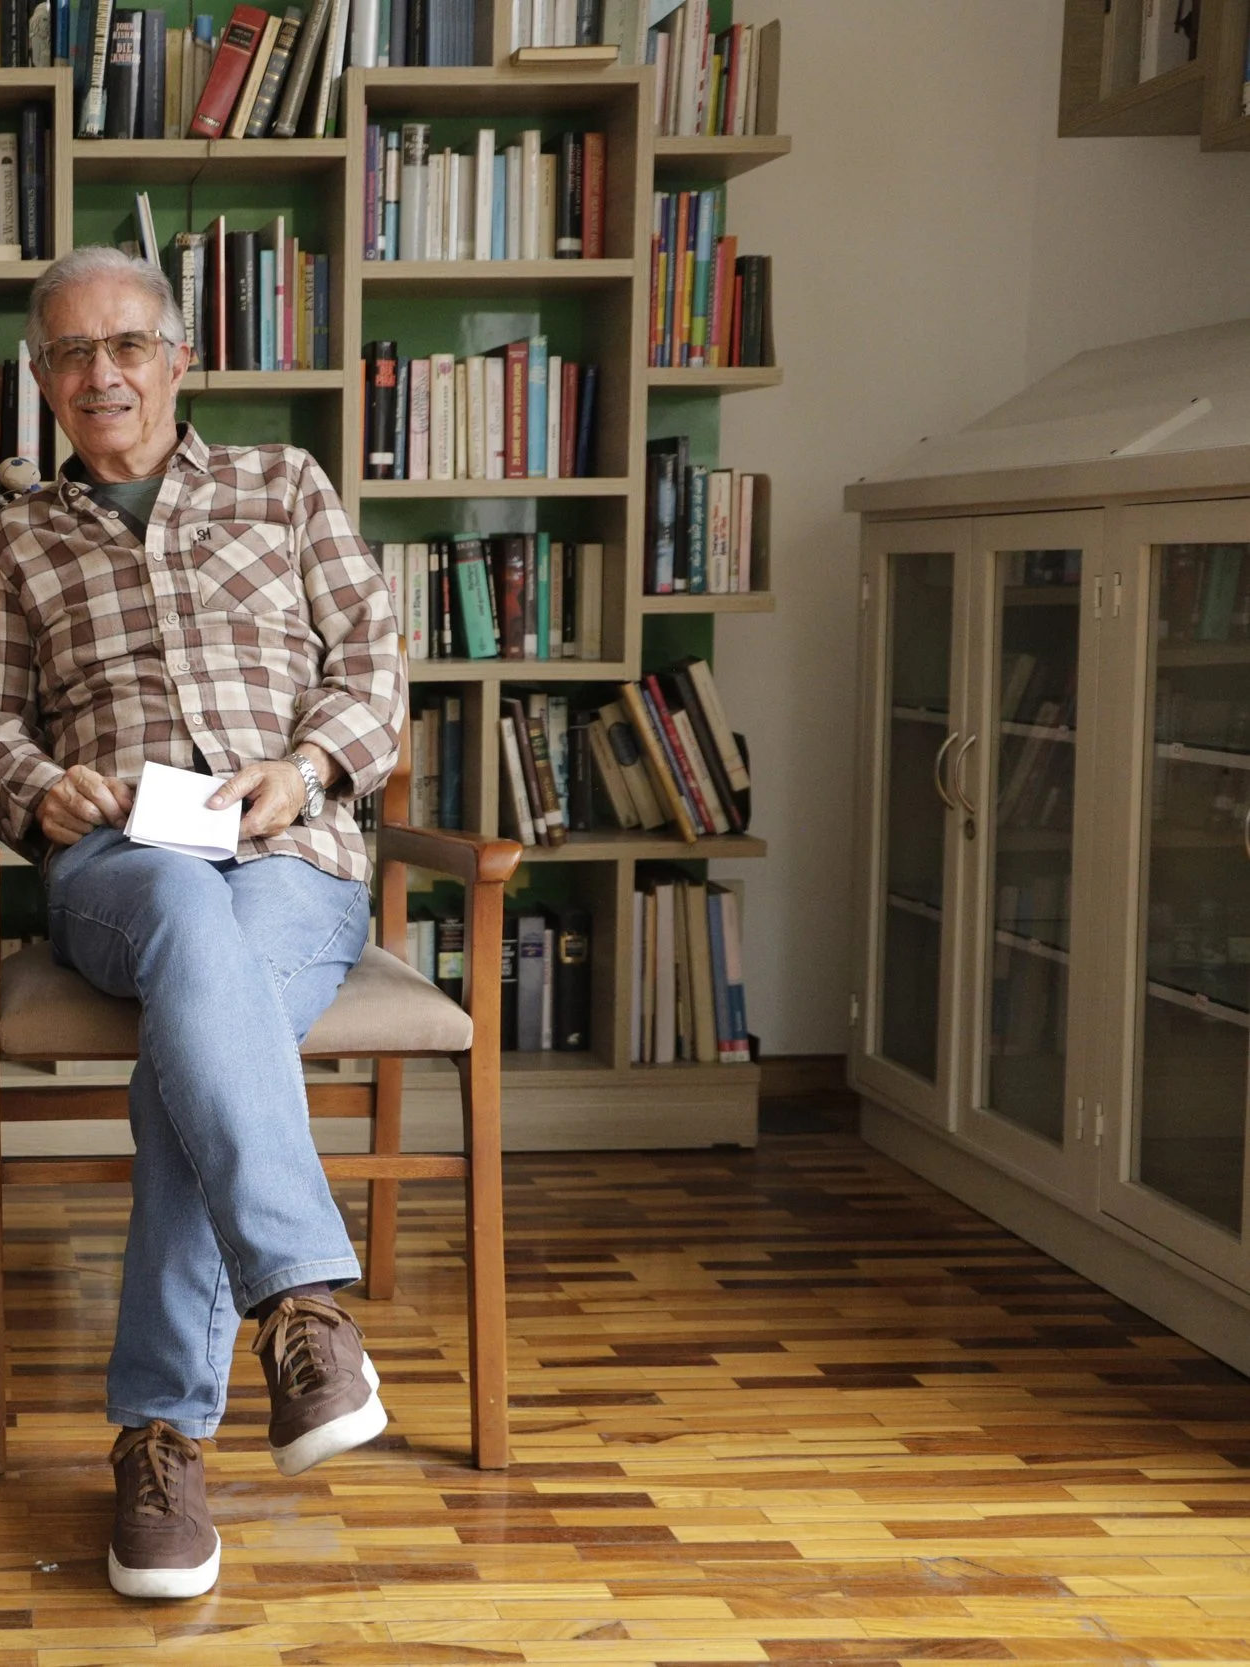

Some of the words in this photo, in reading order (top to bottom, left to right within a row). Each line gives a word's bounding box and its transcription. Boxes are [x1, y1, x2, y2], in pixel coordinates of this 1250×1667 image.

[117, 22, 135, 31] JOHN
[117, 43, 134, 53] DIE
[2, 169, 16, 235] WUNSCHBAUM
[182, 249, 195, 327] MATARESE-BUND
[304, 270, 315, 311] ENGEL
[418, 374, 429, 430] PATTERSON
